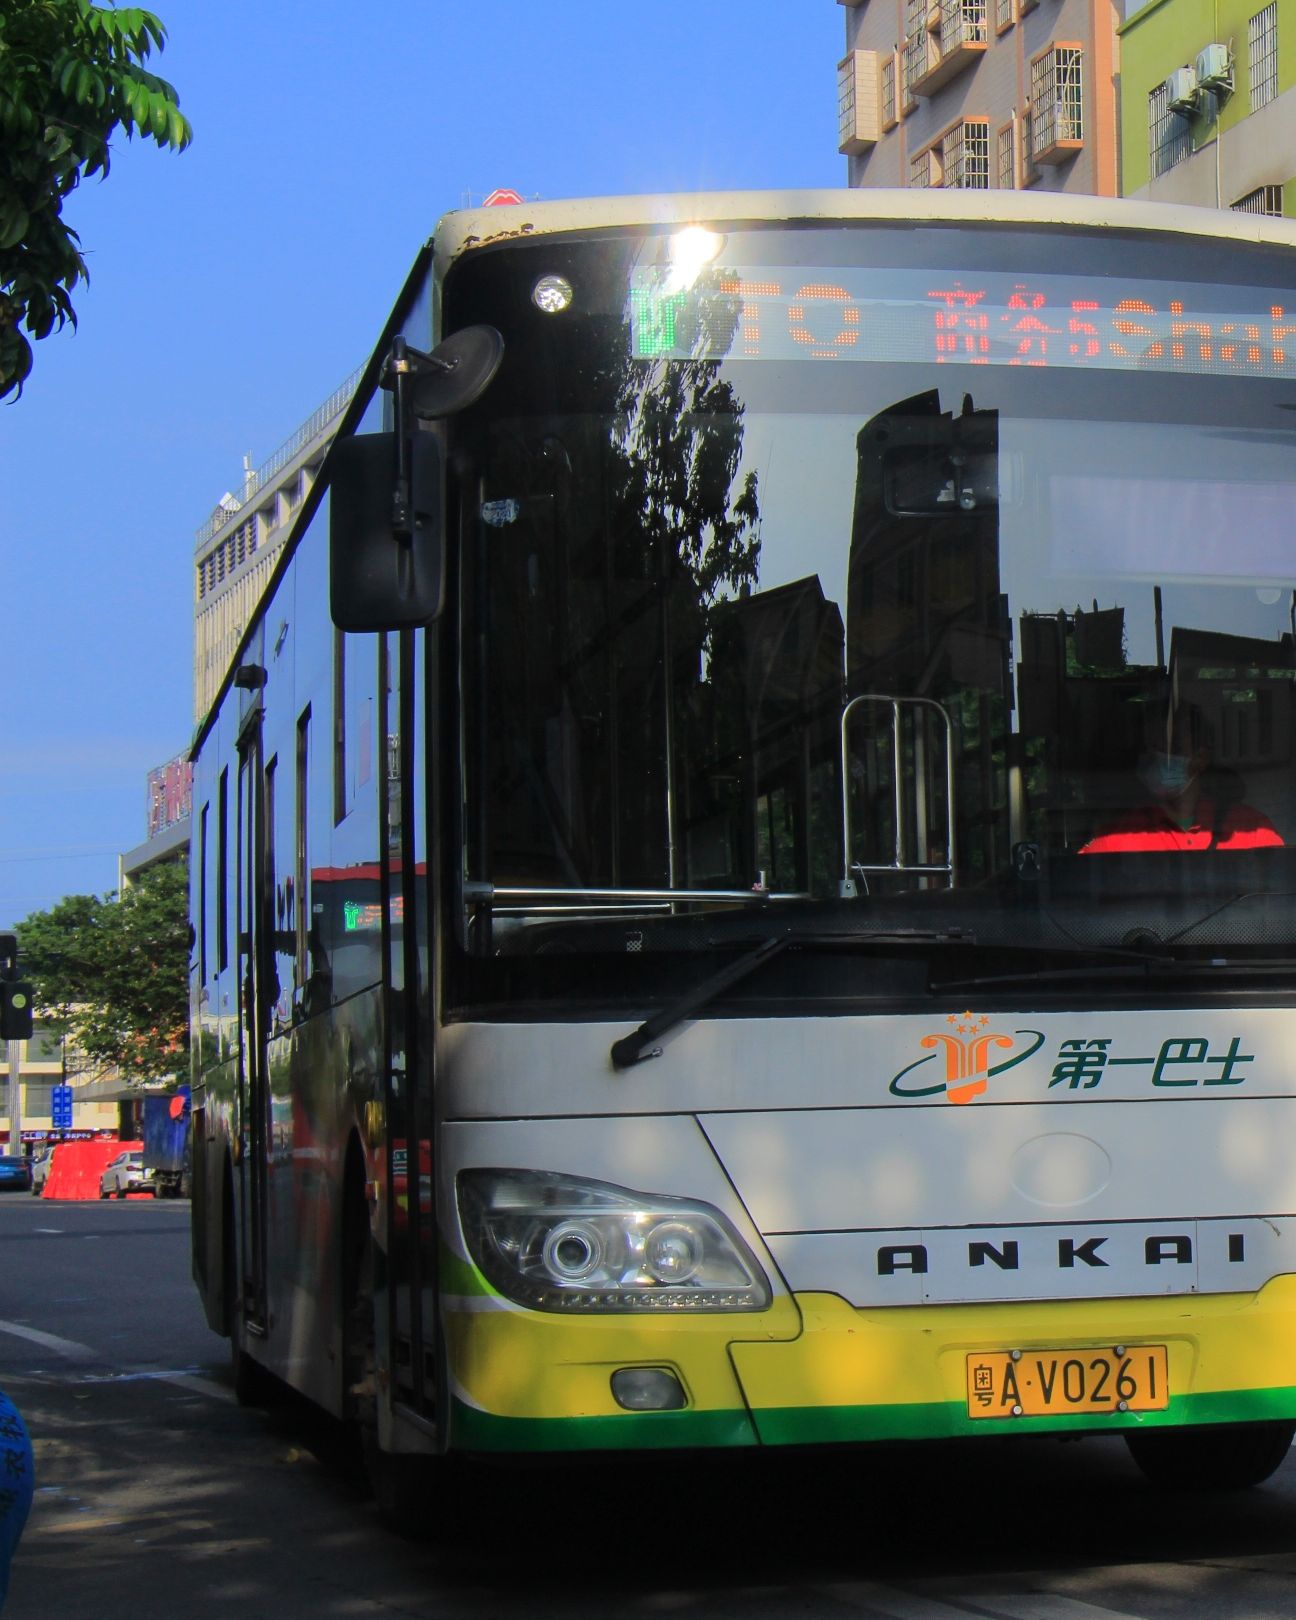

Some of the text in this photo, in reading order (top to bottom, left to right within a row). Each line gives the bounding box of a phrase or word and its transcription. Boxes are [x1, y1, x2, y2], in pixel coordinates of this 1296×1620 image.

[1048, 1037, 1255, 1090] 第一巴士
[876, 1233, 1245, 1276] ANKAI
